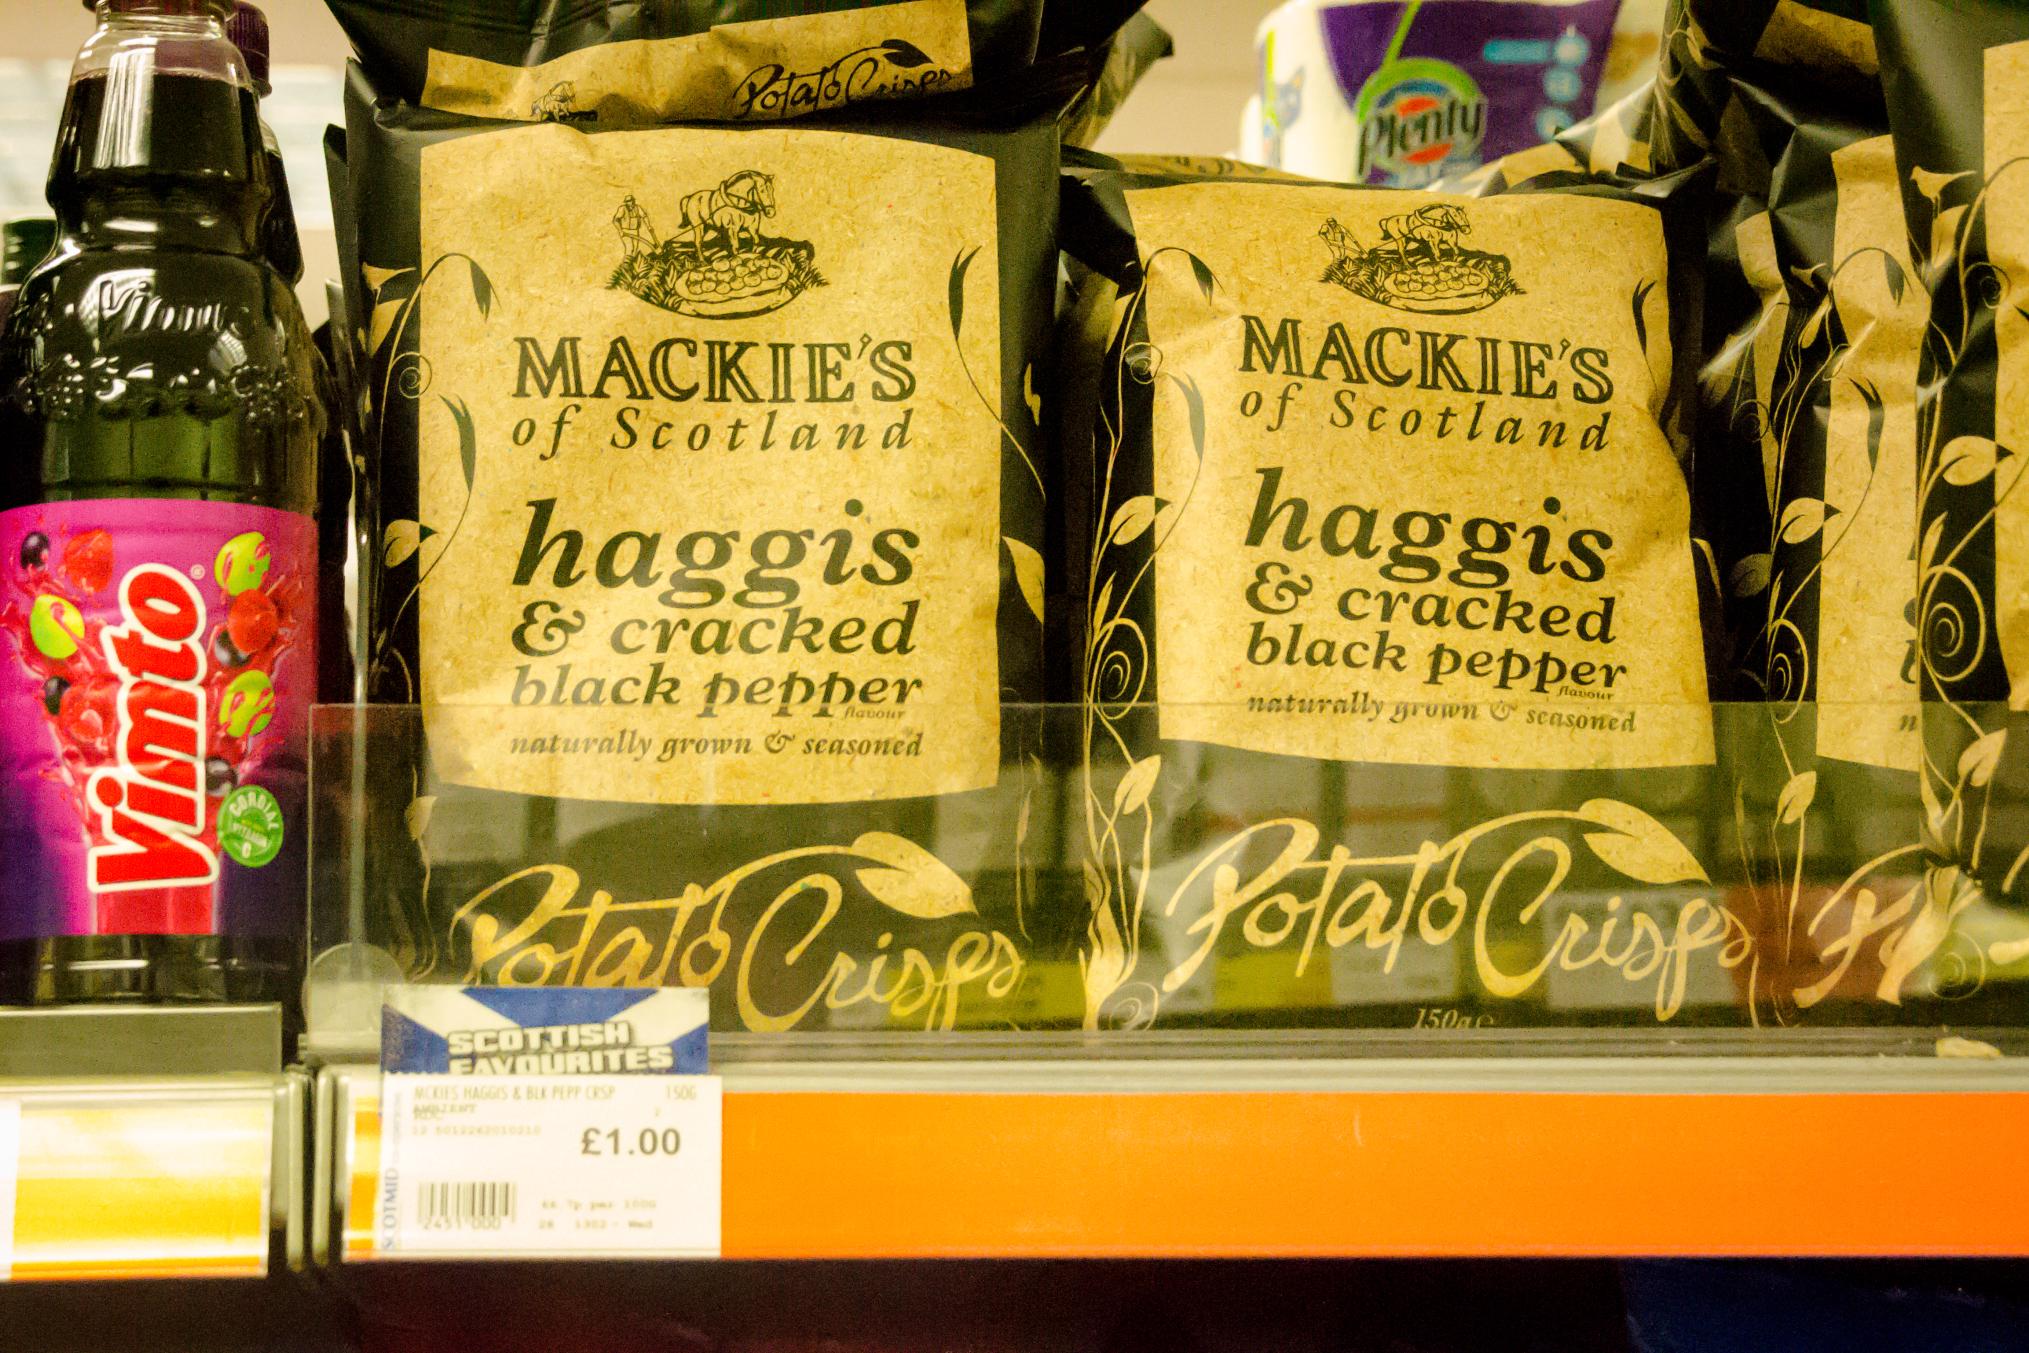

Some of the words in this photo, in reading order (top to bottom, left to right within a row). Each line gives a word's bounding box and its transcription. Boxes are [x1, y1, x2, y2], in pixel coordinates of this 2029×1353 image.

[732, 63, 841, 119] Potato
[511, 332, 917, 404] MACKIE'S
[1238, 315, 1615, 405] MACKIE'S
[511, 403, 581, 460] of
[610, 405, 915, 452] Scotland
[1239, 382, 1303, 433] of
[1329, 388, 1612, 452] Scotland
[511, 496, 920, 610] haggis
[1243, 466, 1613, 590] haggis
[511, 599, 586, 658] &
[609, 598, 922, 656] cracked
[1244, 561, 1314, 616] &
[1337, 586, 1617, 645] cracked
[511, 661, 682, 708] black
[696, 670, 923, 719] pepper
[1246, 621, 1408, 673] black
[1422, 642, 1628, 695] pepper
[843, 706, 906, 721] flavour
[1247, 690, 1385, 722] naturally
[1389, 700, 1479, 725] grown
[1488, 699, 1519, 722] &
[1524, 706, 1638, 733] seasoned
[1556, 684, 1616, 701] flavour
[87, 562, 219, 893] Vimto
[509, 728, 653, 757] naturally
[656, 736, 752, 763] grown
[763, 729, 796, 755] &
[801, 732, 925, 757] seasoned
[448, 863, 733, 987] Potato
[737, 872, 1026, 1033] Crisps
[1162, 817, 1468, 993] Potato
[1473, 835, 1756, 1022] Crisps
[447, 1020, 631, 1055] SCOTTISH
[448, 1045, 674, 1075] FAVOURITES
[580, 1127, 682, 1156] £1.00
[381, 1167, 400, 1251] SOTMID
